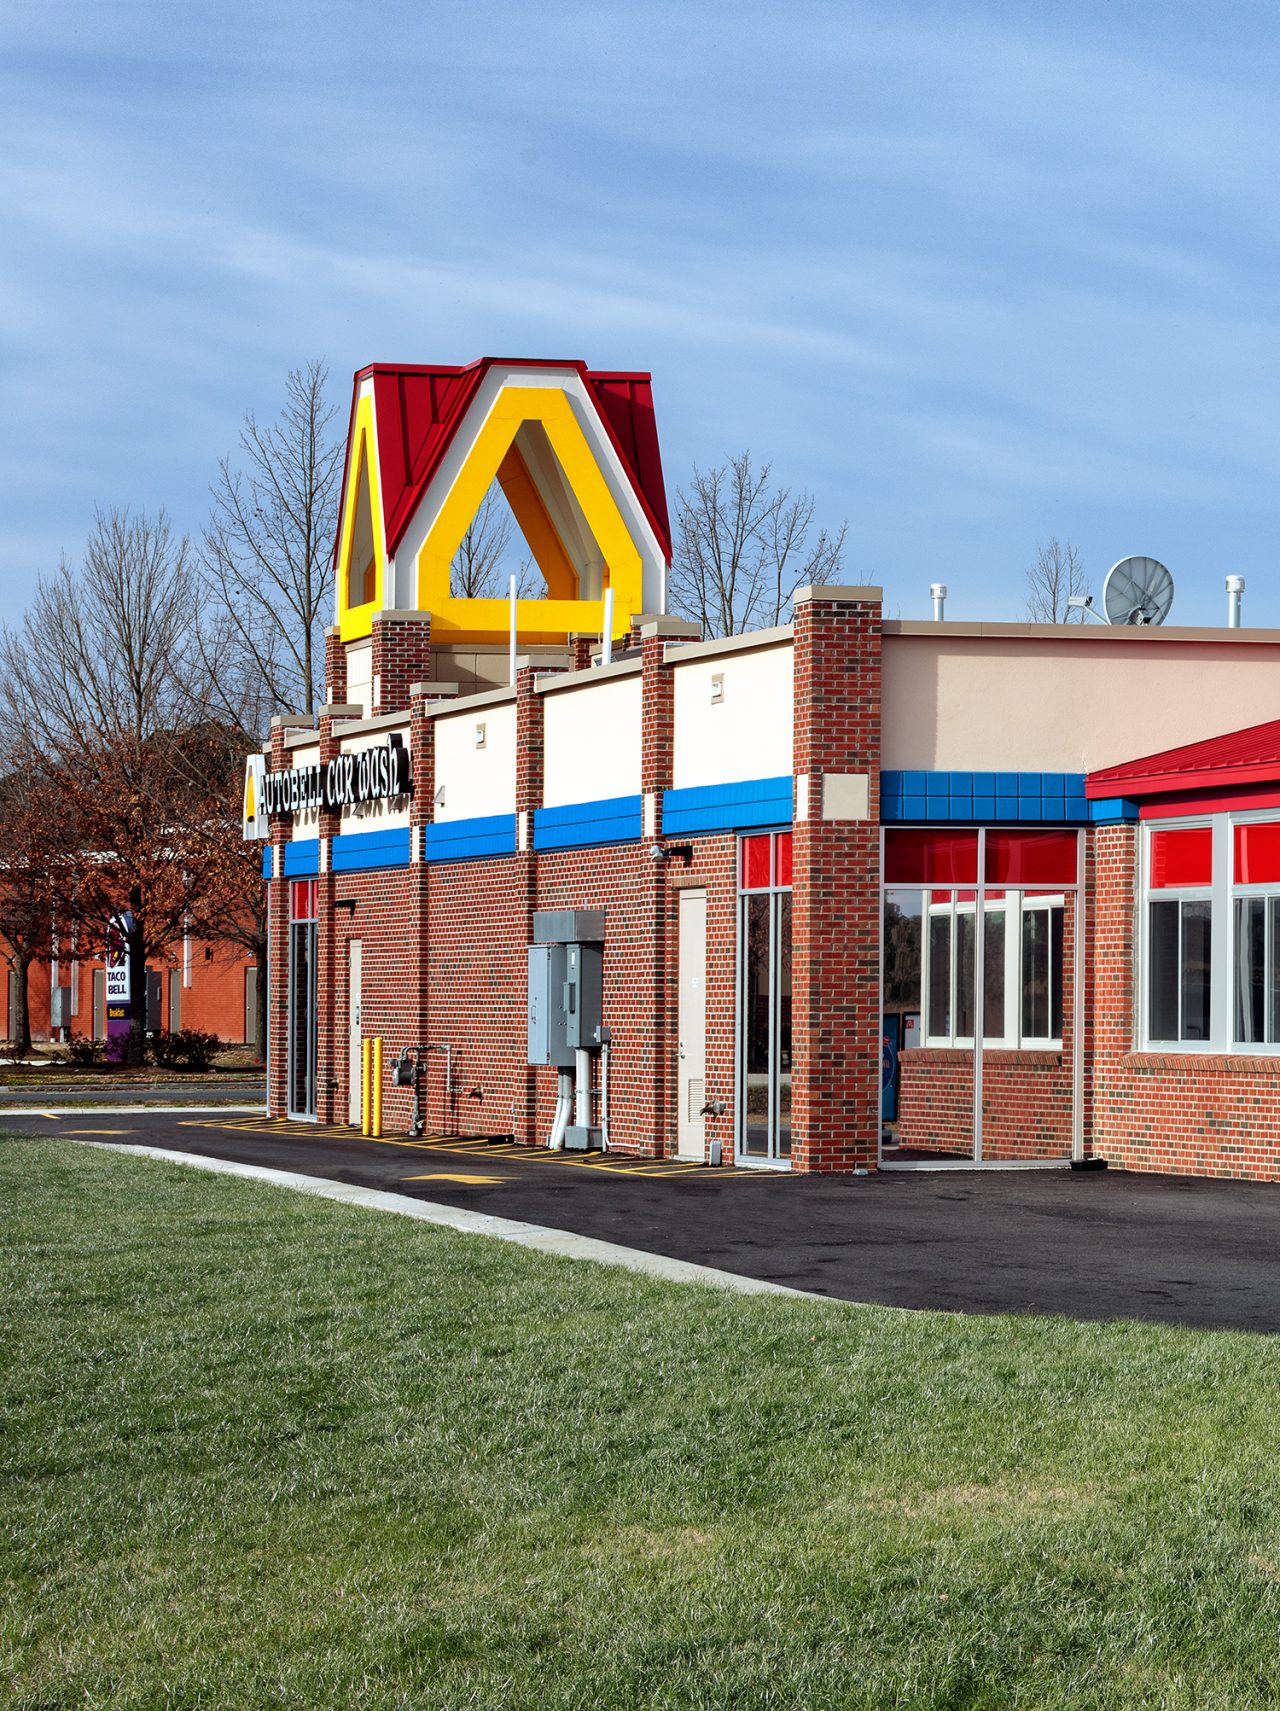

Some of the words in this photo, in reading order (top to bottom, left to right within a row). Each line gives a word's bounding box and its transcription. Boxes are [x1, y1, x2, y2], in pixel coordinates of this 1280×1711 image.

[258, 765, 323, 815] AUTOBELL
[107, 972, 126, 981] TACO
[108, 985, 127, 994] BELL
